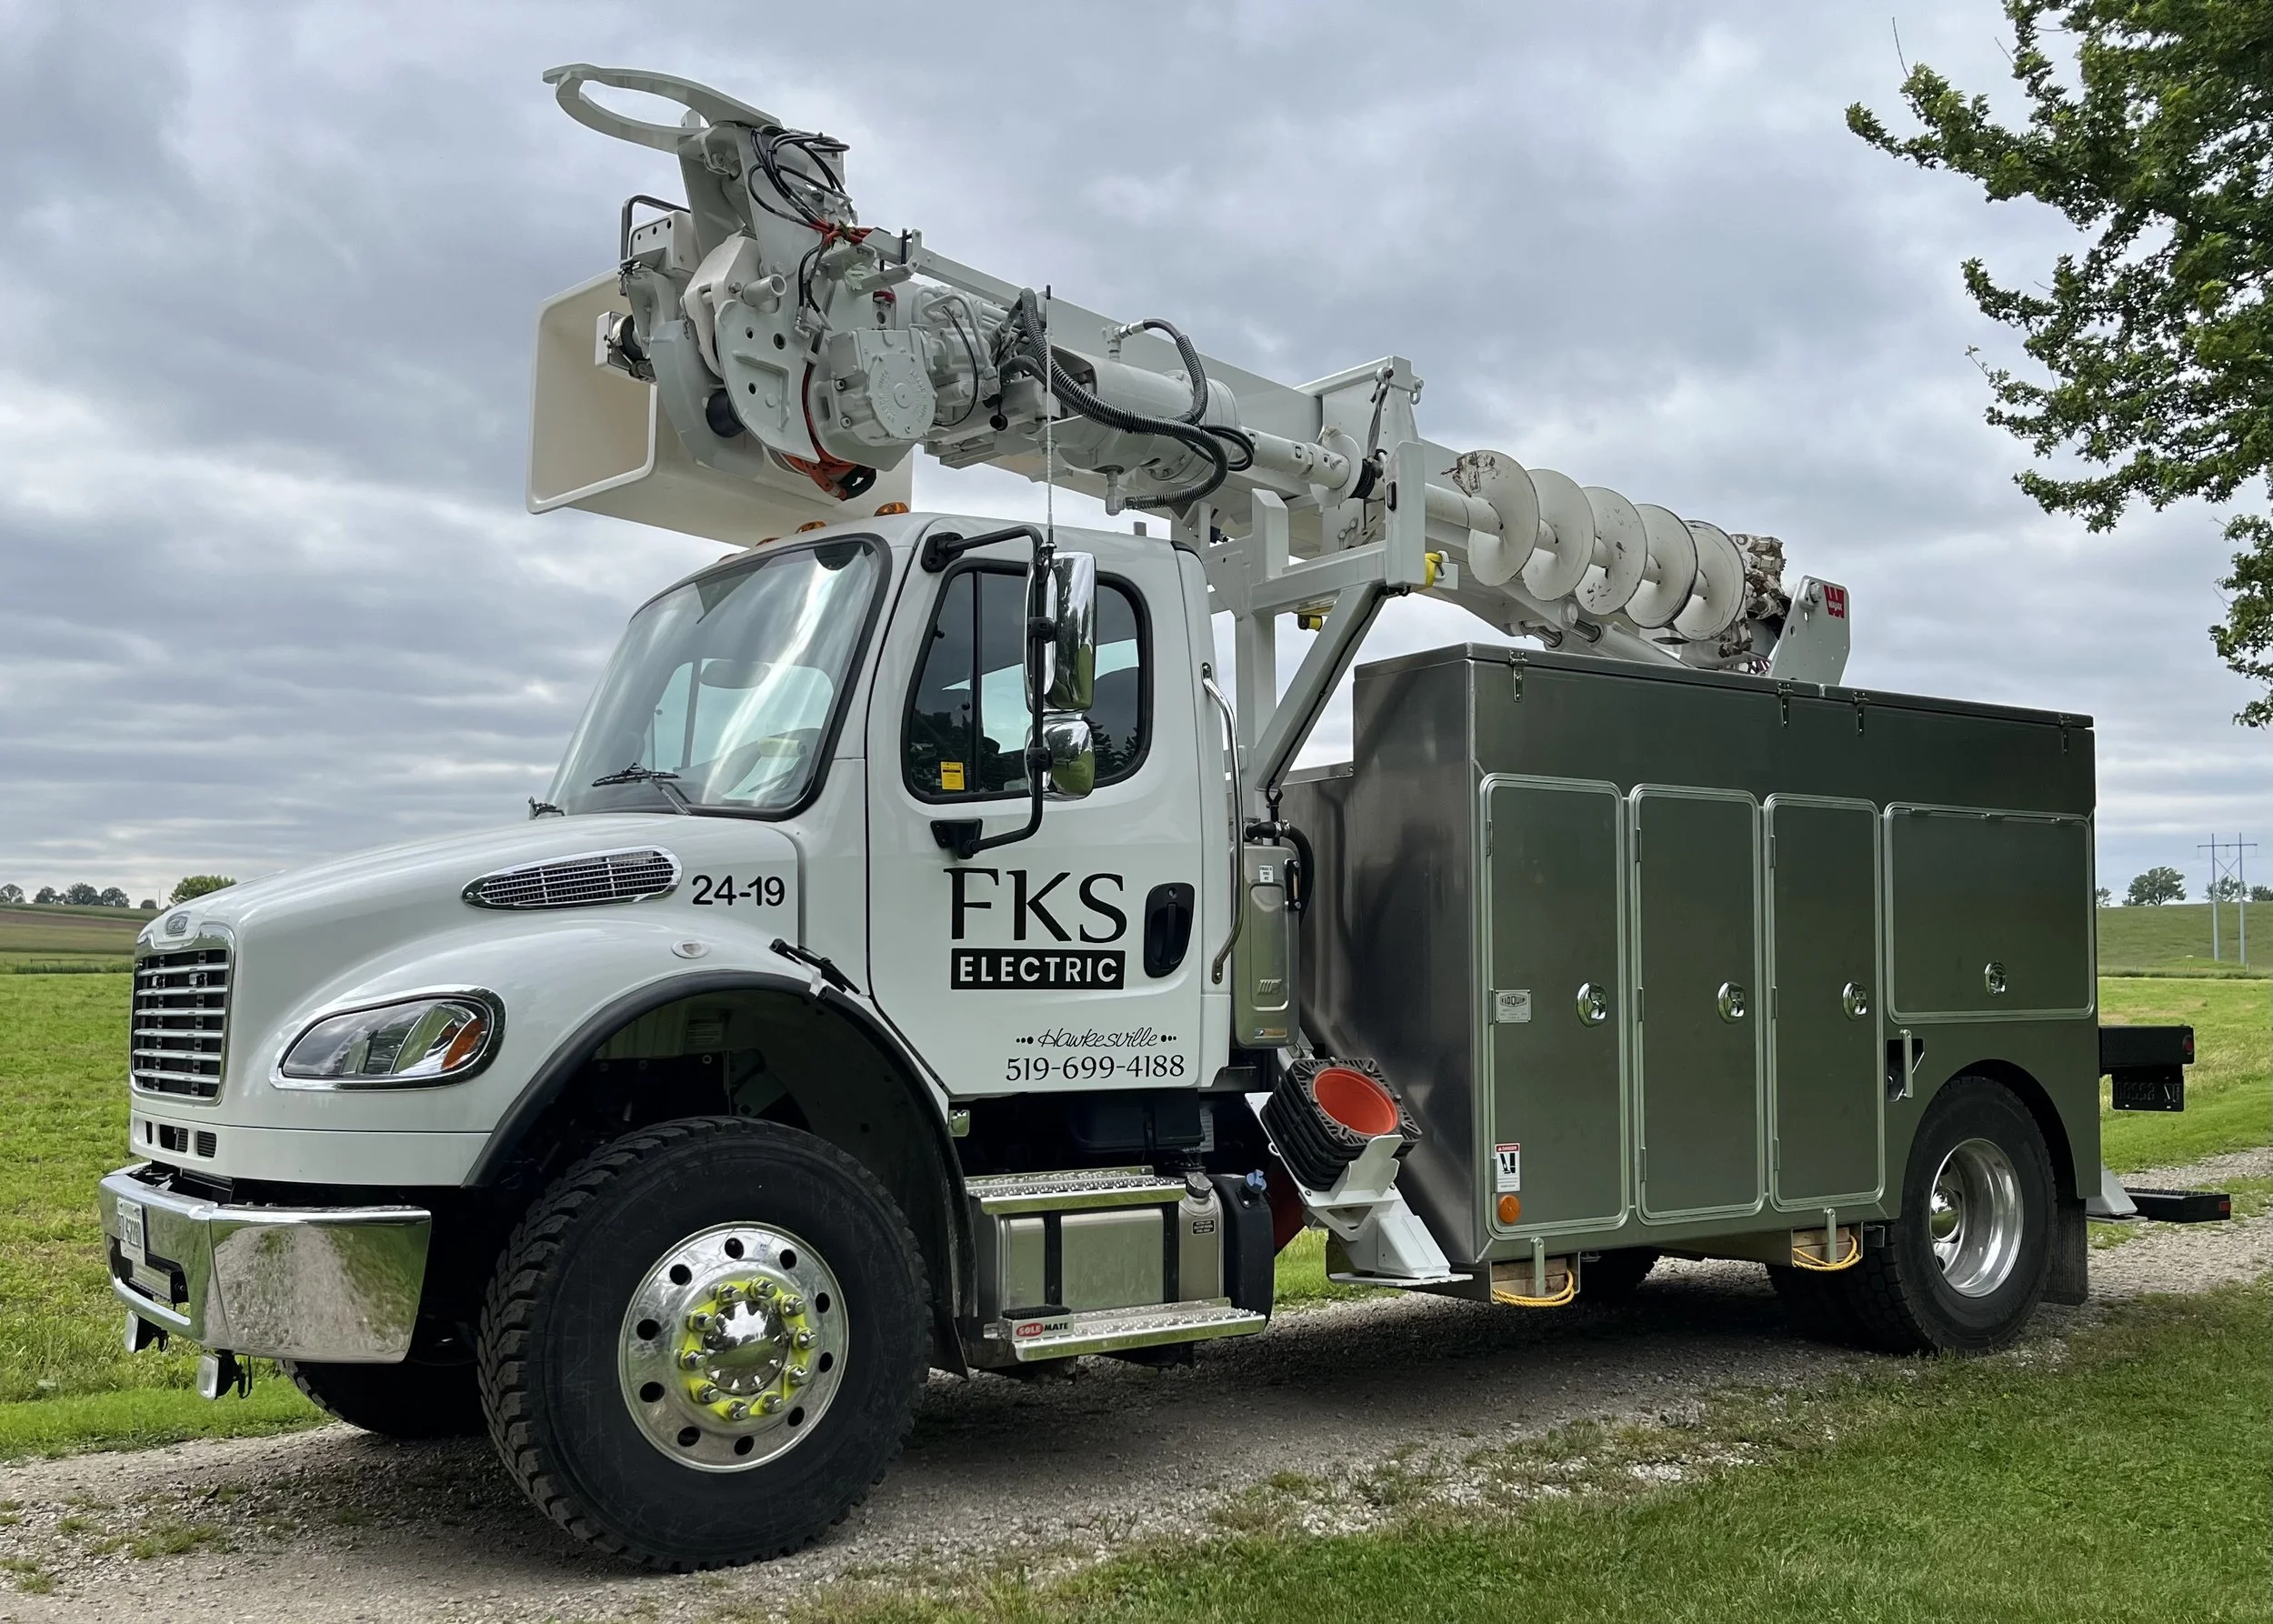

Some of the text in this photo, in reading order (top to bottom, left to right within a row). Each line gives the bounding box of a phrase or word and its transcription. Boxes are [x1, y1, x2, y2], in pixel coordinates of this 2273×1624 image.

[692, 875, 786, 907] 24-19
[943, 867, 1127, 944] FKS
[959, 957, 1117, 983] ELECTRIC
[1037, 1027, 1158, 1048] Hawkesville
[1006, 1054, 1185, 1081] 519-699-4188
[1018, 1322, 1069, 1336] SOLE MATE
